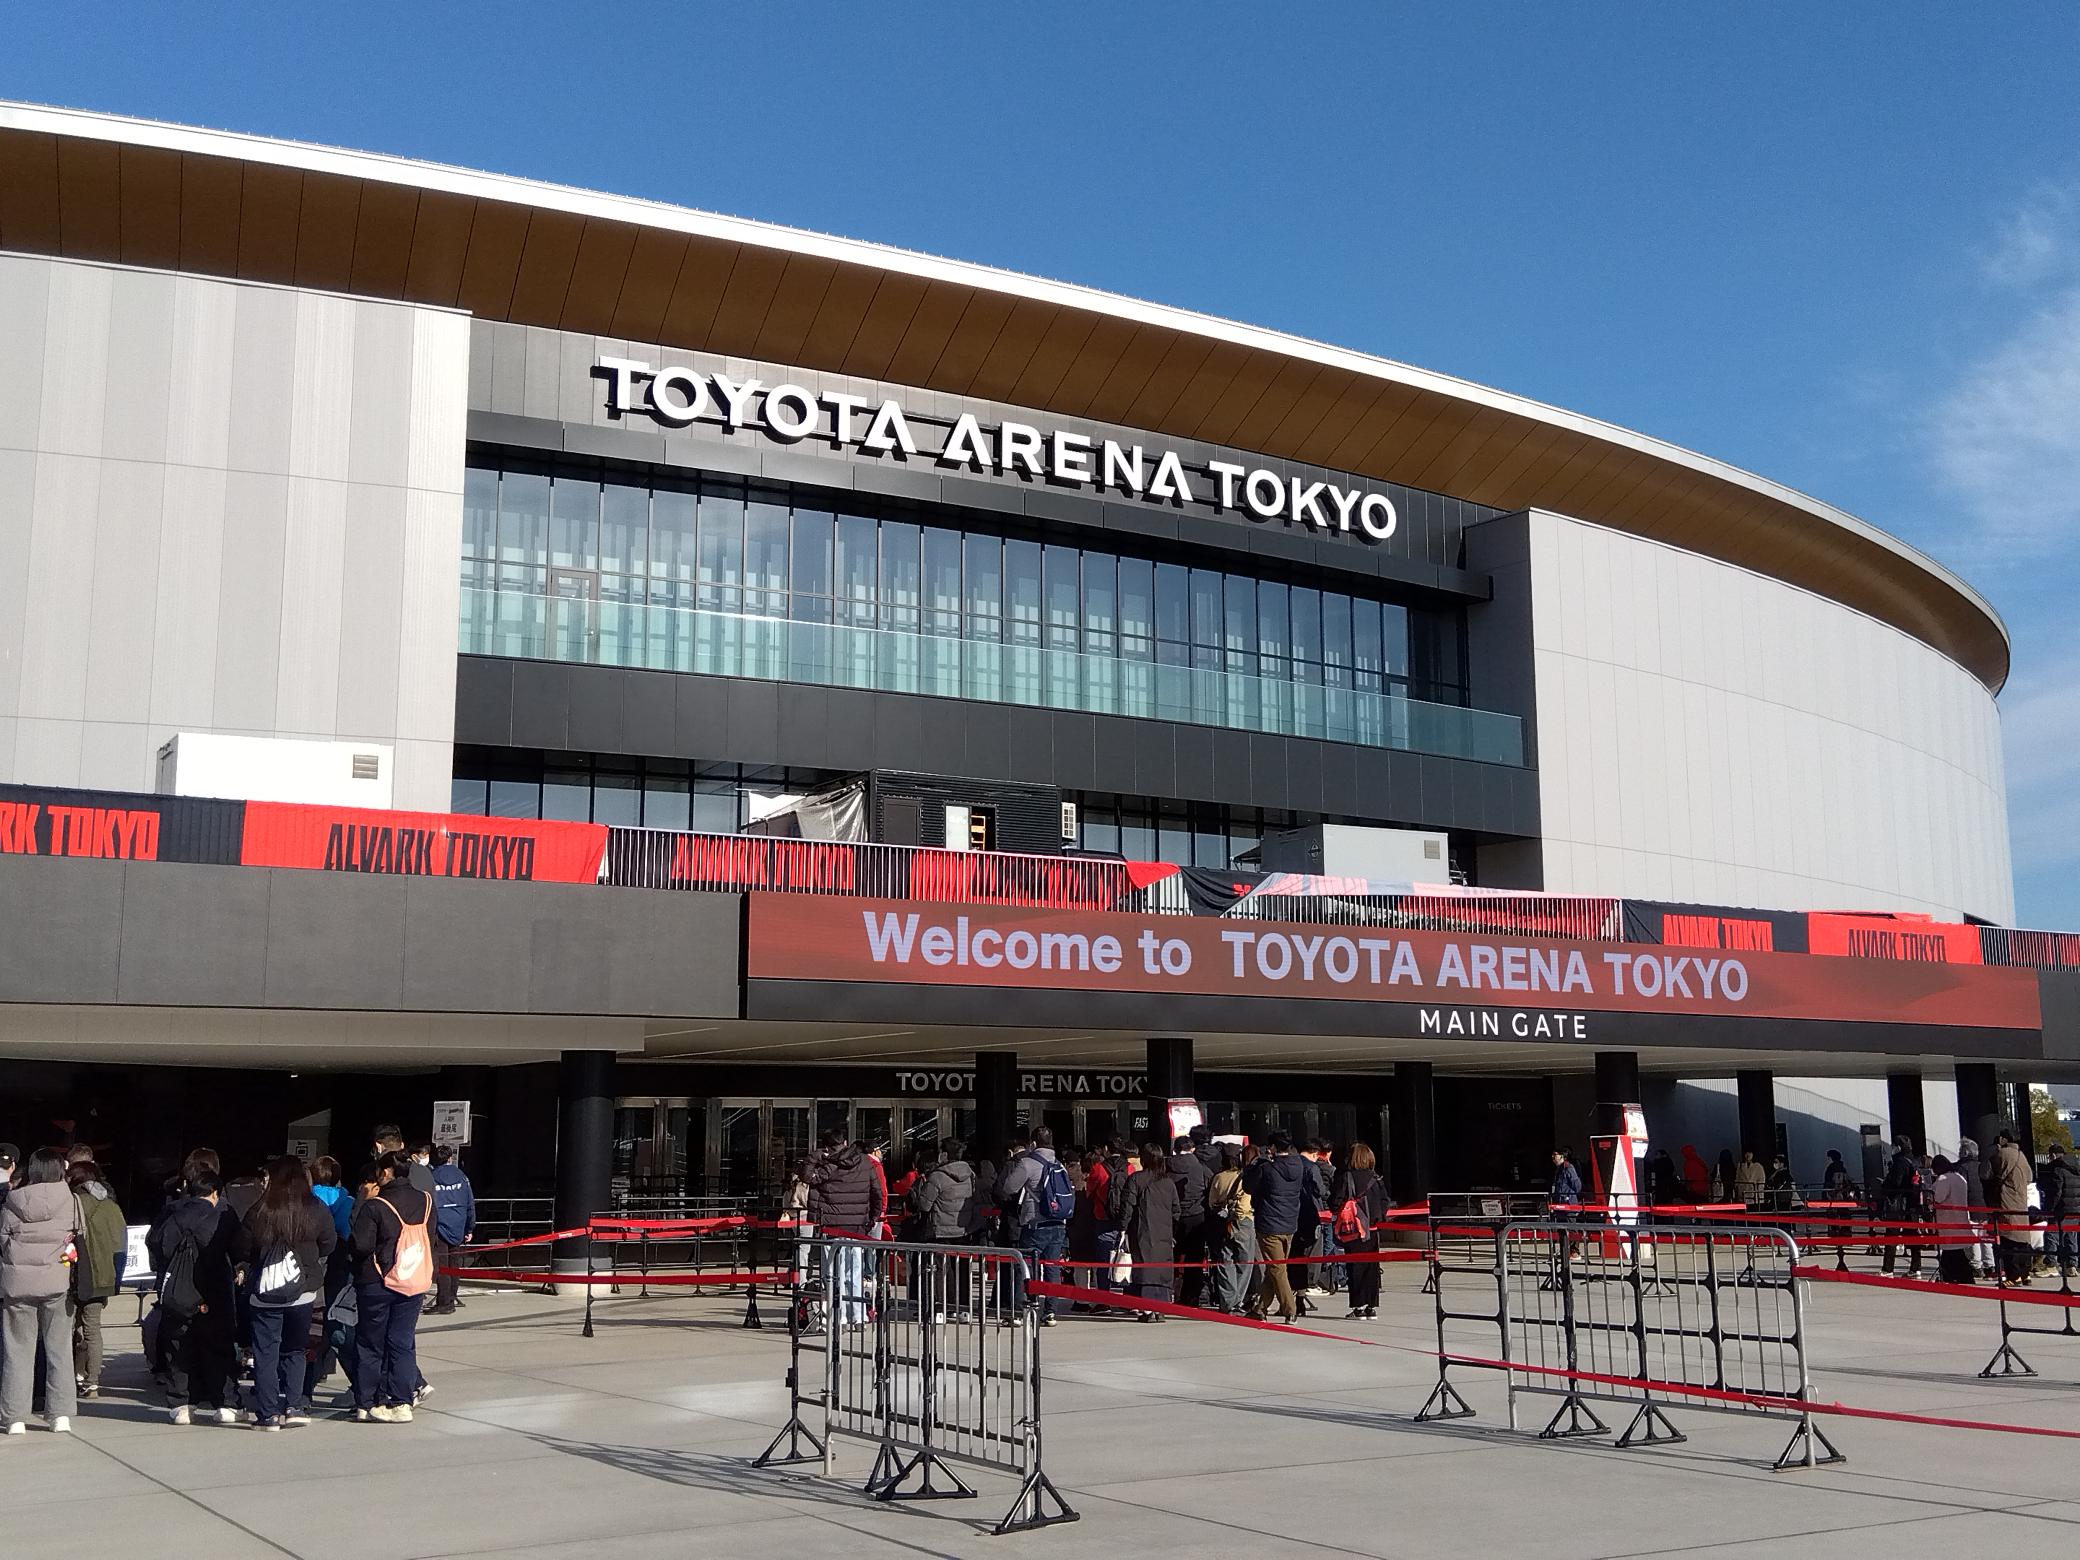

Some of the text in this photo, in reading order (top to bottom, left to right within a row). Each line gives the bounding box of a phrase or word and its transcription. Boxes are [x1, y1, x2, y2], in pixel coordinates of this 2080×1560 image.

[600, 356, 1397, 539] TOYOTA ARENA TOKYO
[48, 806, 160, 861] TOKYO
[324, 822, 536, 882] ALVARK TOKYO
[1664, 914, 1773, 953] ALVARK TOKYO
[862, 911, 1748, 1001] Welcome to TOYOTA ARENA TOKYO
[1420, 1009, 1587, 1039] MAIN GATE
[1016, 1074, 1090, 1093] RENA
[1095, 1075, 1148, 1094] TOK
[1487, 1102, 1522, 1111] TICKETS
[435, 1183, 462, 1191] STAFF
[259, 1250, 301, 1294] NIKE
